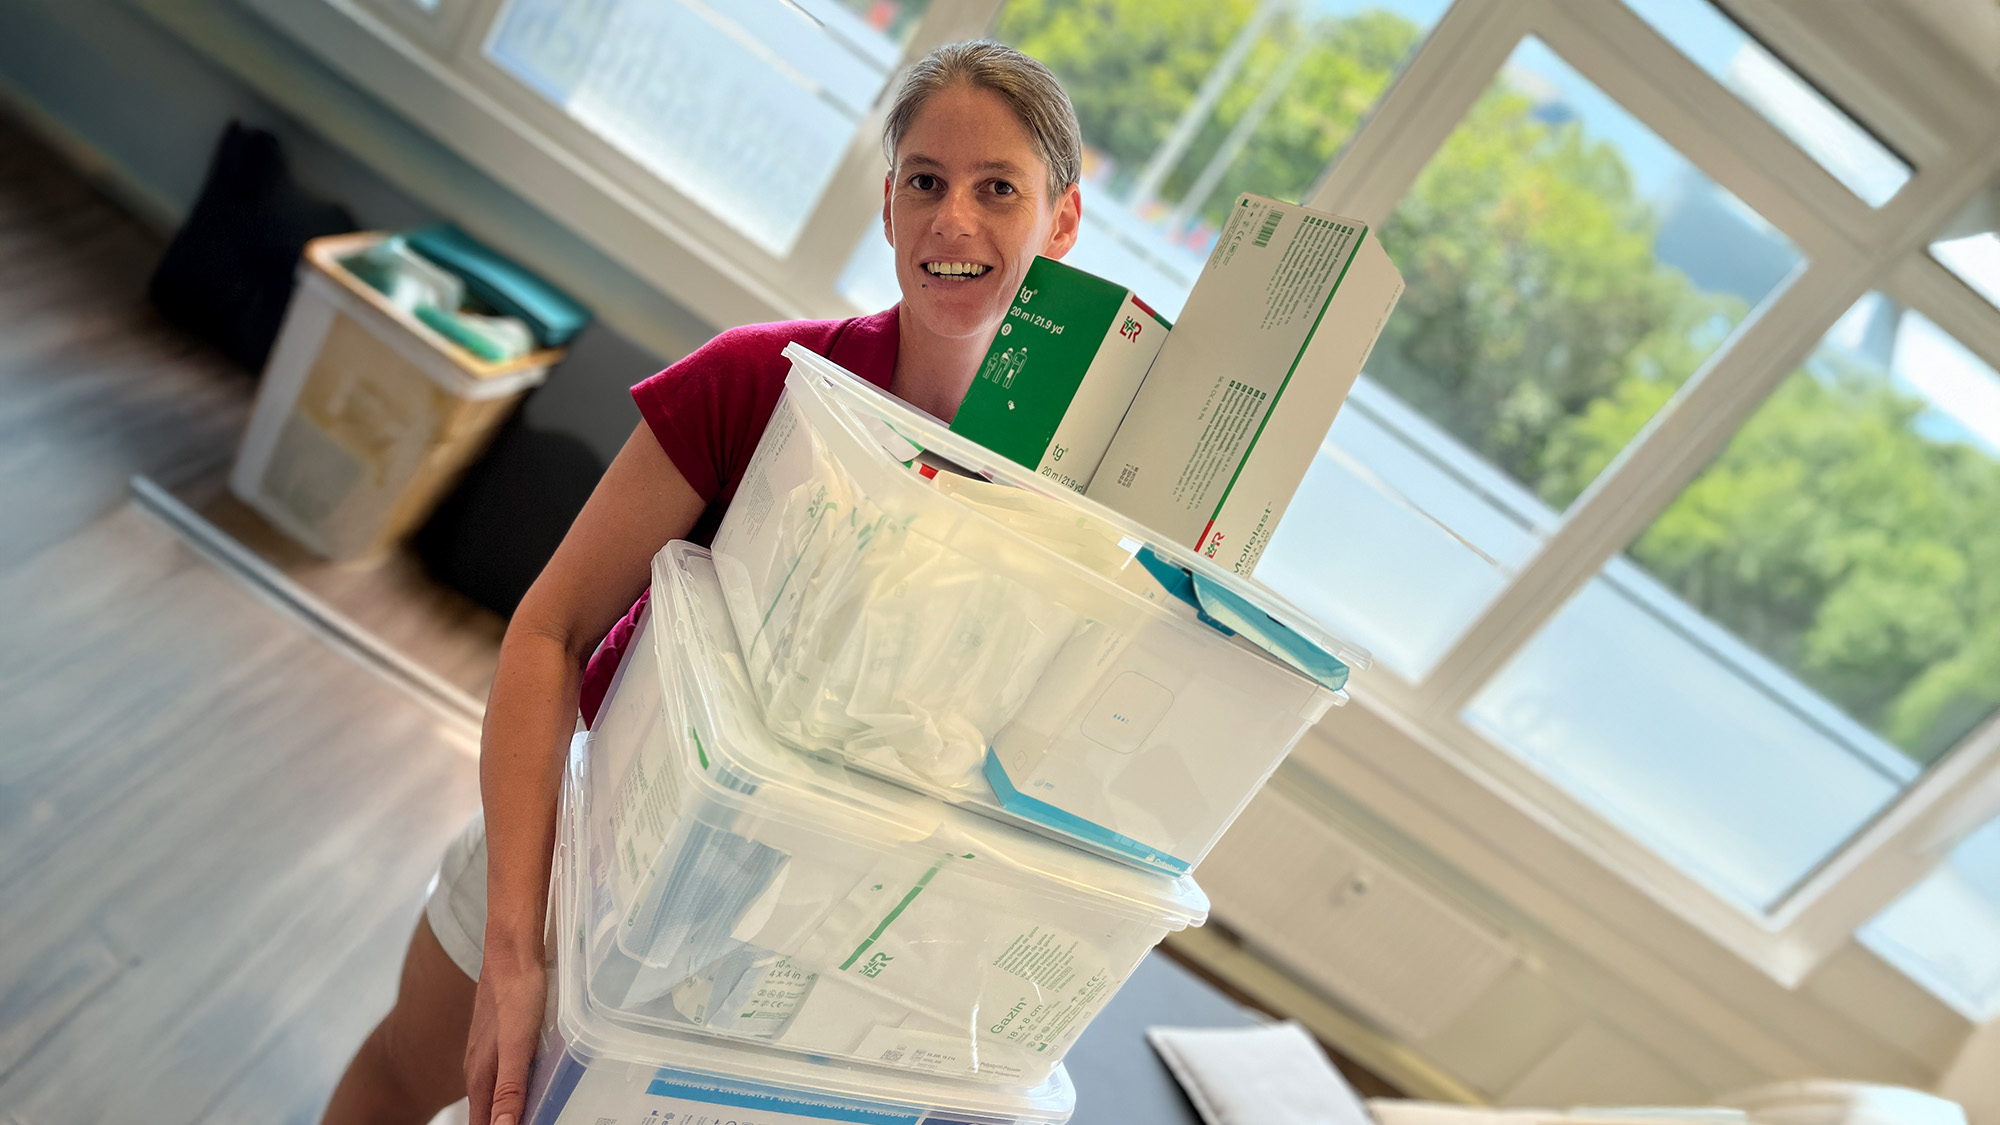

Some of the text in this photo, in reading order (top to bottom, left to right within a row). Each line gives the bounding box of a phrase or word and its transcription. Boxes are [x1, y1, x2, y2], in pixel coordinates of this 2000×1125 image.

[1010, 306, 1022, 316] 20
[1021, 312, 1030, 320] m
[1034, 316, 1052, 329] 21.9
[1050, 324, 1064, 334] yd
[1042, 466, 1052, 476] 20
[1051, 472, 1058, 480] m
[1061, 476, 1076, 488] 21.9
[1074, 484, 1084, 492] yd
[1006, 1031, 1018, 1040] 18
[1030, 1004, 1044, 1017] cm
